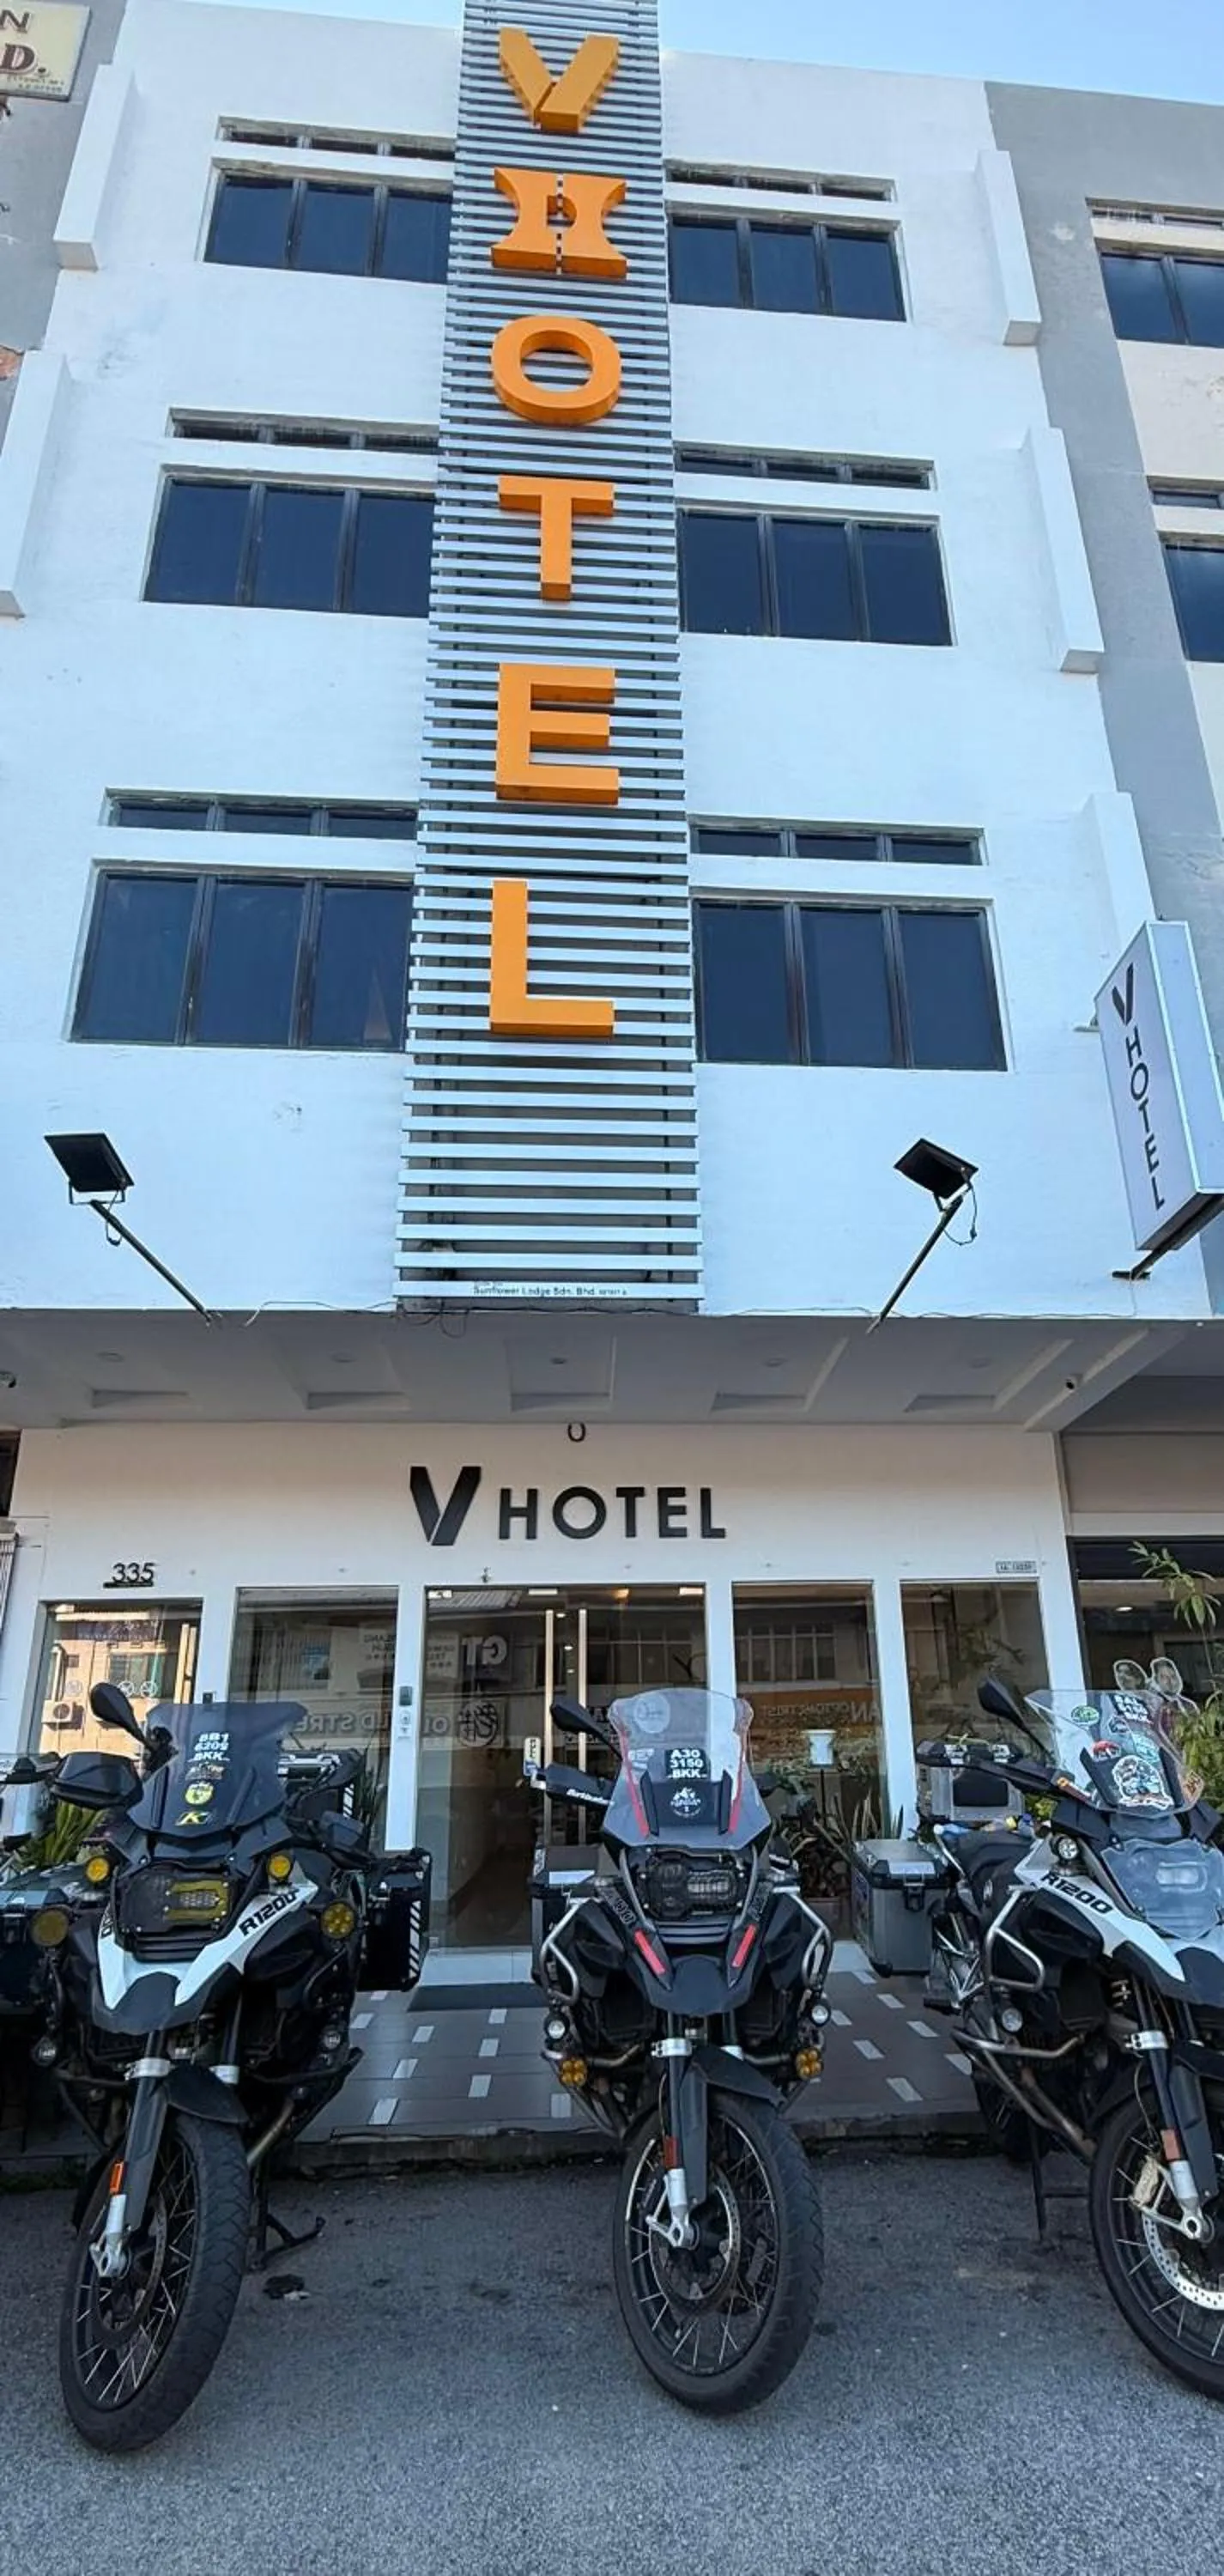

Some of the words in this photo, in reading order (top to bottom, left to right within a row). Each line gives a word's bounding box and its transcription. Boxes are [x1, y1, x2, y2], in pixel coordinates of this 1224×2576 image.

[1112, 962, 1134, 1026] V
[1124, 1025, 1166, 1212] HOTEL
[521, 1286, 551, 1298] Lodge
[409, 1466, 482, 1546] V
[499, 1485, 726, 1540] HOTEL
[112, 1562, 155, 1584] 335
[670, 1749, 701, 1759] A30
[1040, 1871, 1113, 1914] R1200
